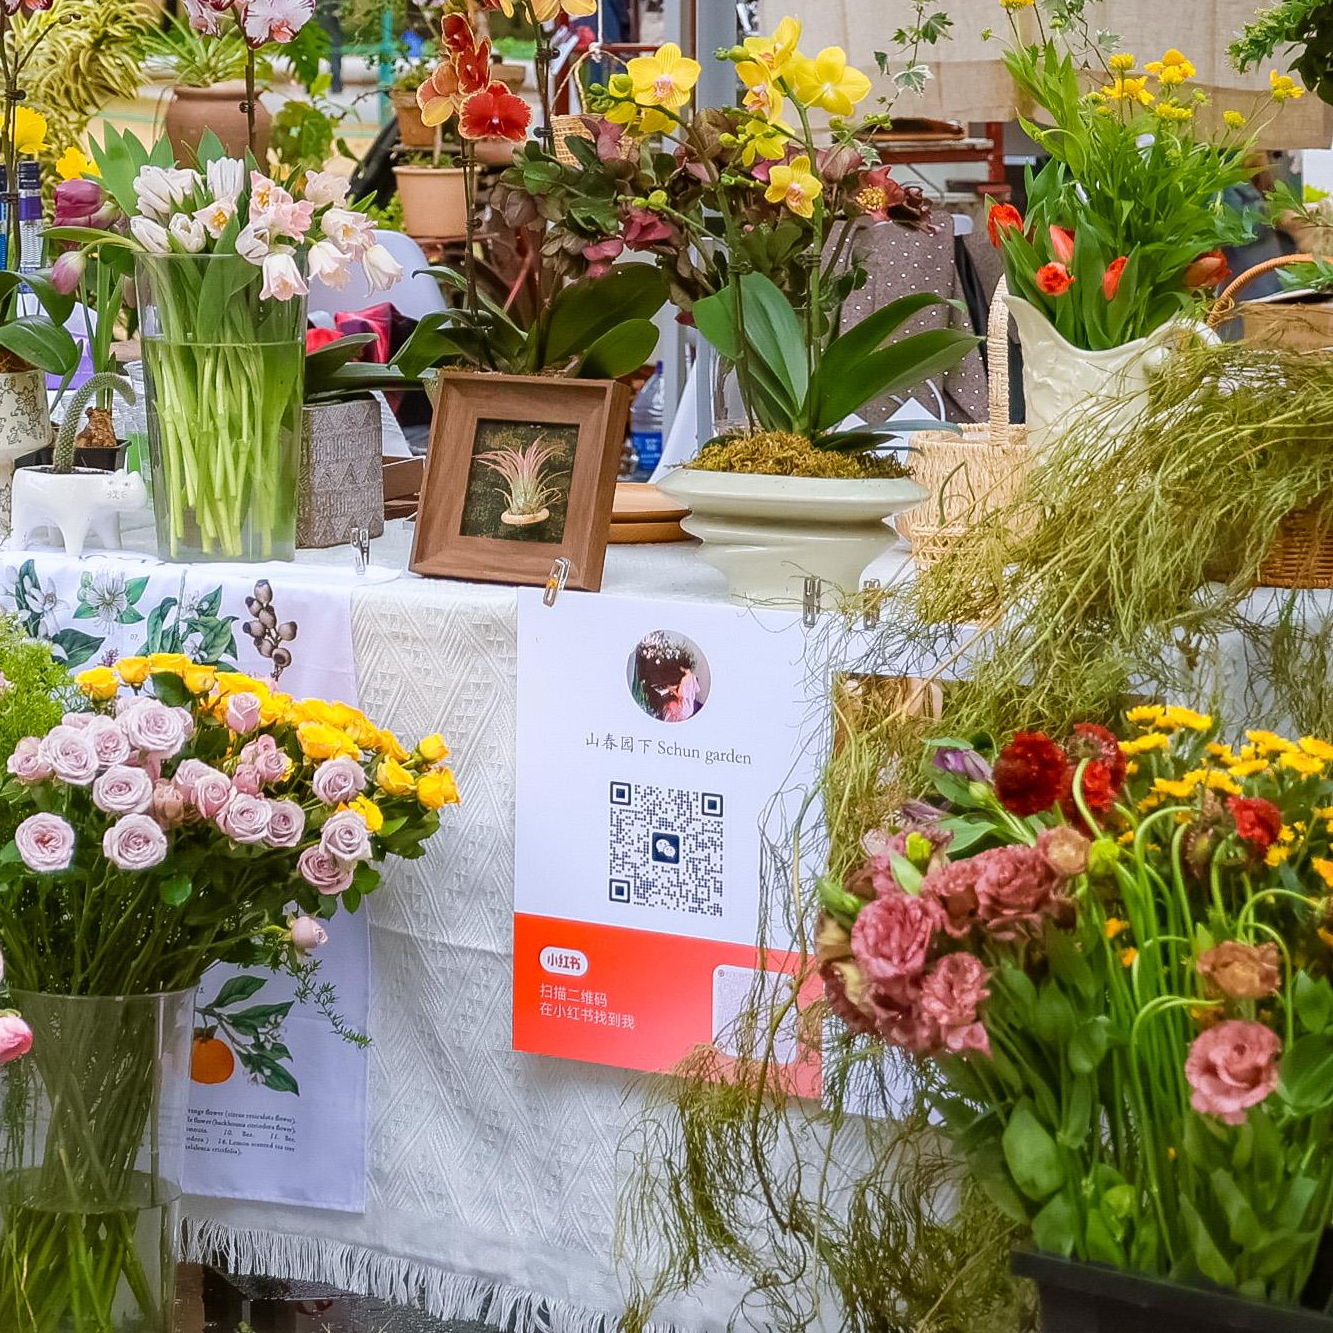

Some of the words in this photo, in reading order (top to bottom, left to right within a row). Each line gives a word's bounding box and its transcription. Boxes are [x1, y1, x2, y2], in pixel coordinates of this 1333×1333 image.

[586, 732, 653, 754] 山春园下
[657, 741, 700, 759] Schun
[705, 749, 752, 765] garden
[547, 953, 581, 971] 小红书
[540, 983, 608, 1008] 扫描二维码
[540, 1001, 635, 1030] 在小红书找到我
